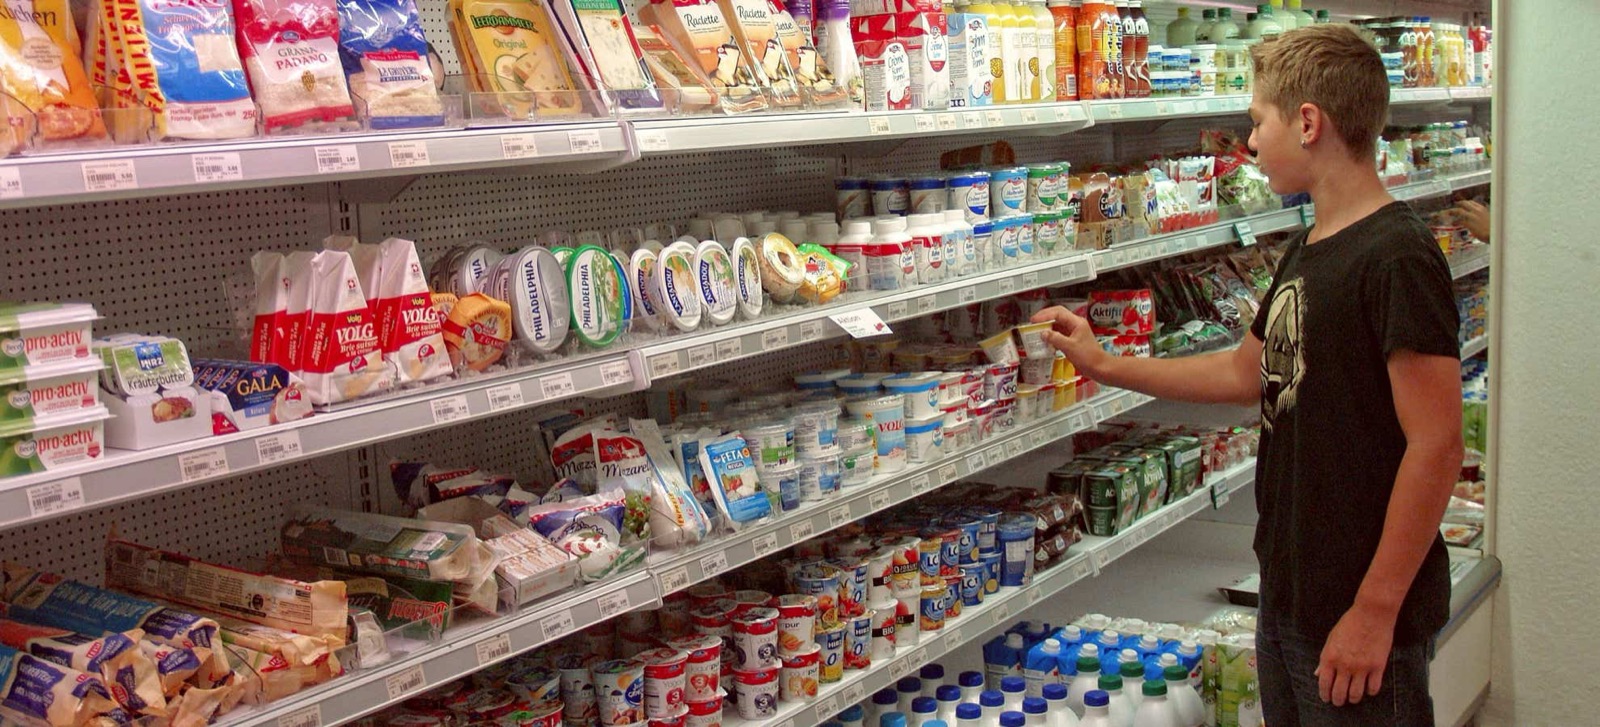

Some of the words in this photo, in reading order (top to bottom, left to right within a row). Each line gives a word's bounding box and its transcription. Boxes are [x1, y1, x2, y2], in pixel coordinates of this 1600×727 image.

[684, 13, 719, 28] Raclette
[737, 6, 767, 19] Raclette
[471, 15, 539, 33] LEERDAMMER
[278, 46, 318, 58] GRANA
[493, 39, 527, 50] Original
[276, 53, 328, 70] PADANO
[700, 259, 718, 304] CANTADOU
[523, 260, 546, 341] PHILADELPHIA
[583, 264, 592, 329] PHILADELPHIA
[665, 267, 684, 316] CANTADOU
[402, 306, 437, 325] VOLG
[336, 323, 374, 344] VOLG
[127, 372, 187, 391] Kräuterbutter
[236, 376, 282, 396] GALA
[720, 449, 743, 464] FETA
